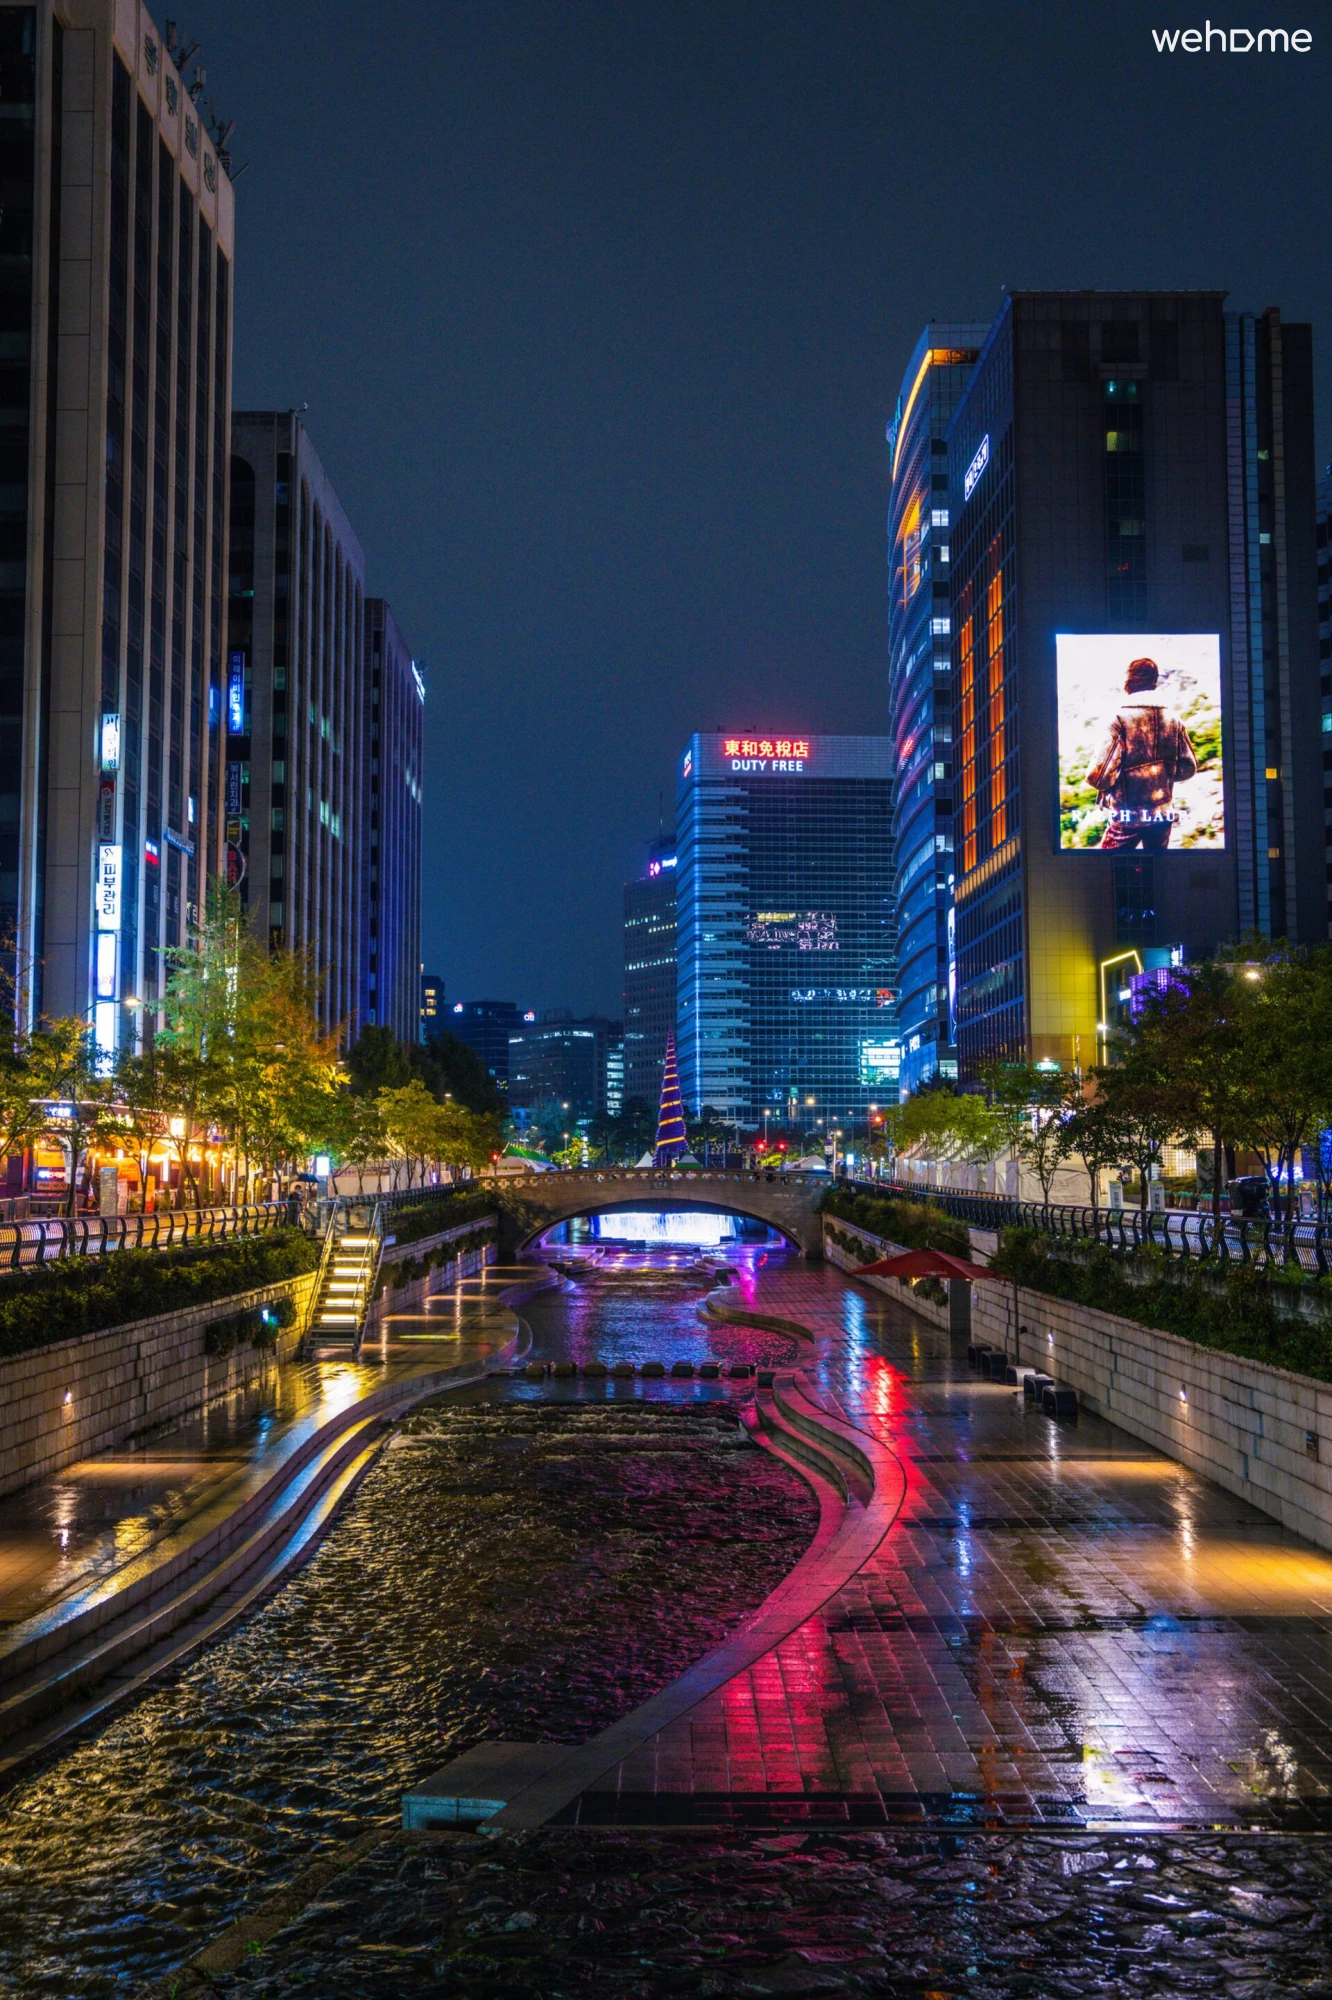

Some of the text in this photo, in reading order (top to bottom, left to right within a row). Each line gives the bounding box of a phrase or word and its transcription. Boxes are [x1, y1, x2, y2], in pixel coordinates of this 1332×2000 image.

[732, 759, 803, 771] DUTY FREE
[1071, 809, 1131, 823] RPH
[103, 863, 116, 915] 피부관리
